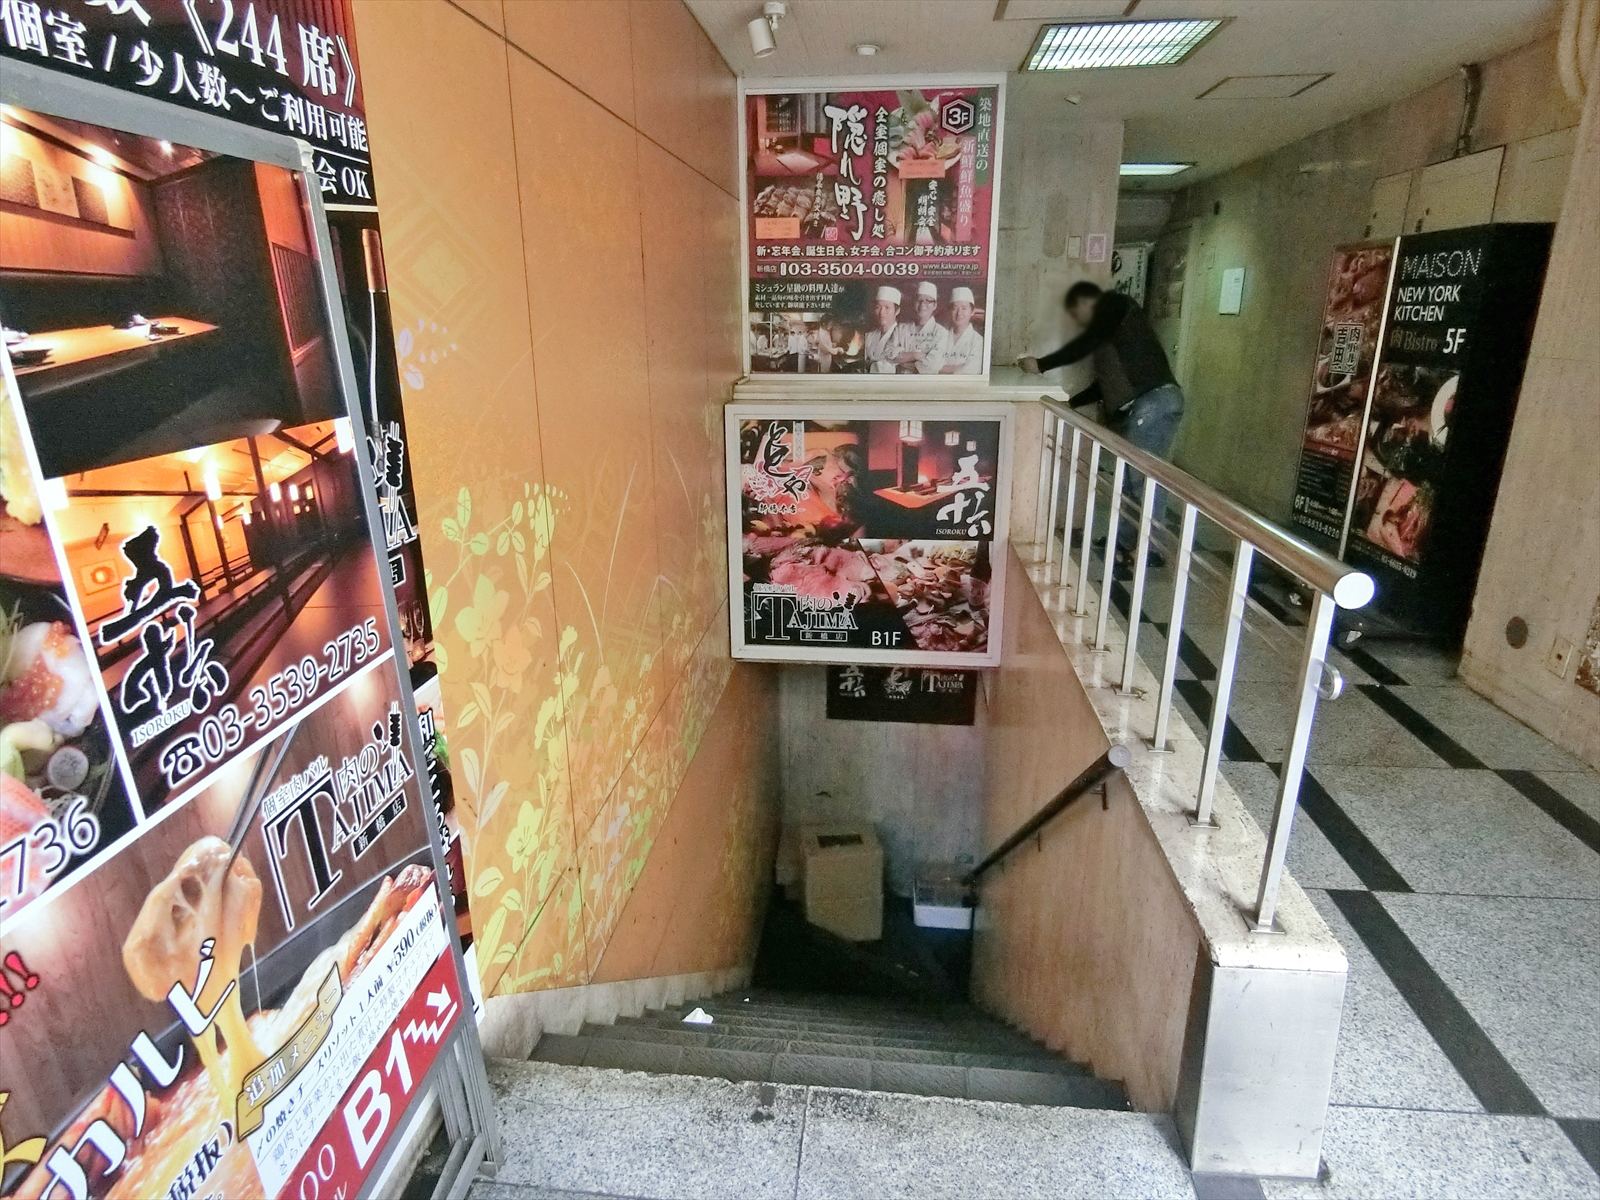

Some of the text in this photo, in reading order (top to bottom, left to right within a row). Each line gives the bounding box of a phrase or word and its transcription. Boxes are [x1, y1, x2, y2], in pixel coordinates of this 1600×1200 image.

[948, 107, 969, 125] 3F
[976, 97, 991, 171] 築地直送の
[341, 166, 372, 200] OK
[824, 104, 869, 241] 隠れ野
[871, 106, 889, 239] 全室個室の癒し処
[788, 262, 920, 276] 03-3504-0039
[922, 262, 979, 271] www.kakureya.jp
[1401, 248, 1482, 280] MAISON
[1393, 305, 1445, 322] KITCHEN
[1397, 284, 1462, 302] NEW YORK
[1442, 328, 1467, 354] 5F
[935, 527, 967, 536] ISOROKU
[755, 593, 860, 641] TAJIMA
[800, 594, 833, 613] 肉の
[871, 630, 902, 646] B1F
[200, 618, 381, 761] 03-3539-2735
[130, 699, 192, 748] ISOROKU
[263, 755, 329, 818] 個室肉バル
[336, 744, 379, 802] 肉の
[272, 748, 415, 910] TAJIMA
[356, 801, 405, 851] 新橋店
[0, 798, 100, 908] 736
[244, 986, 338, 1107] 追加メニュー
[342, 1028, 413, 1172] B1
